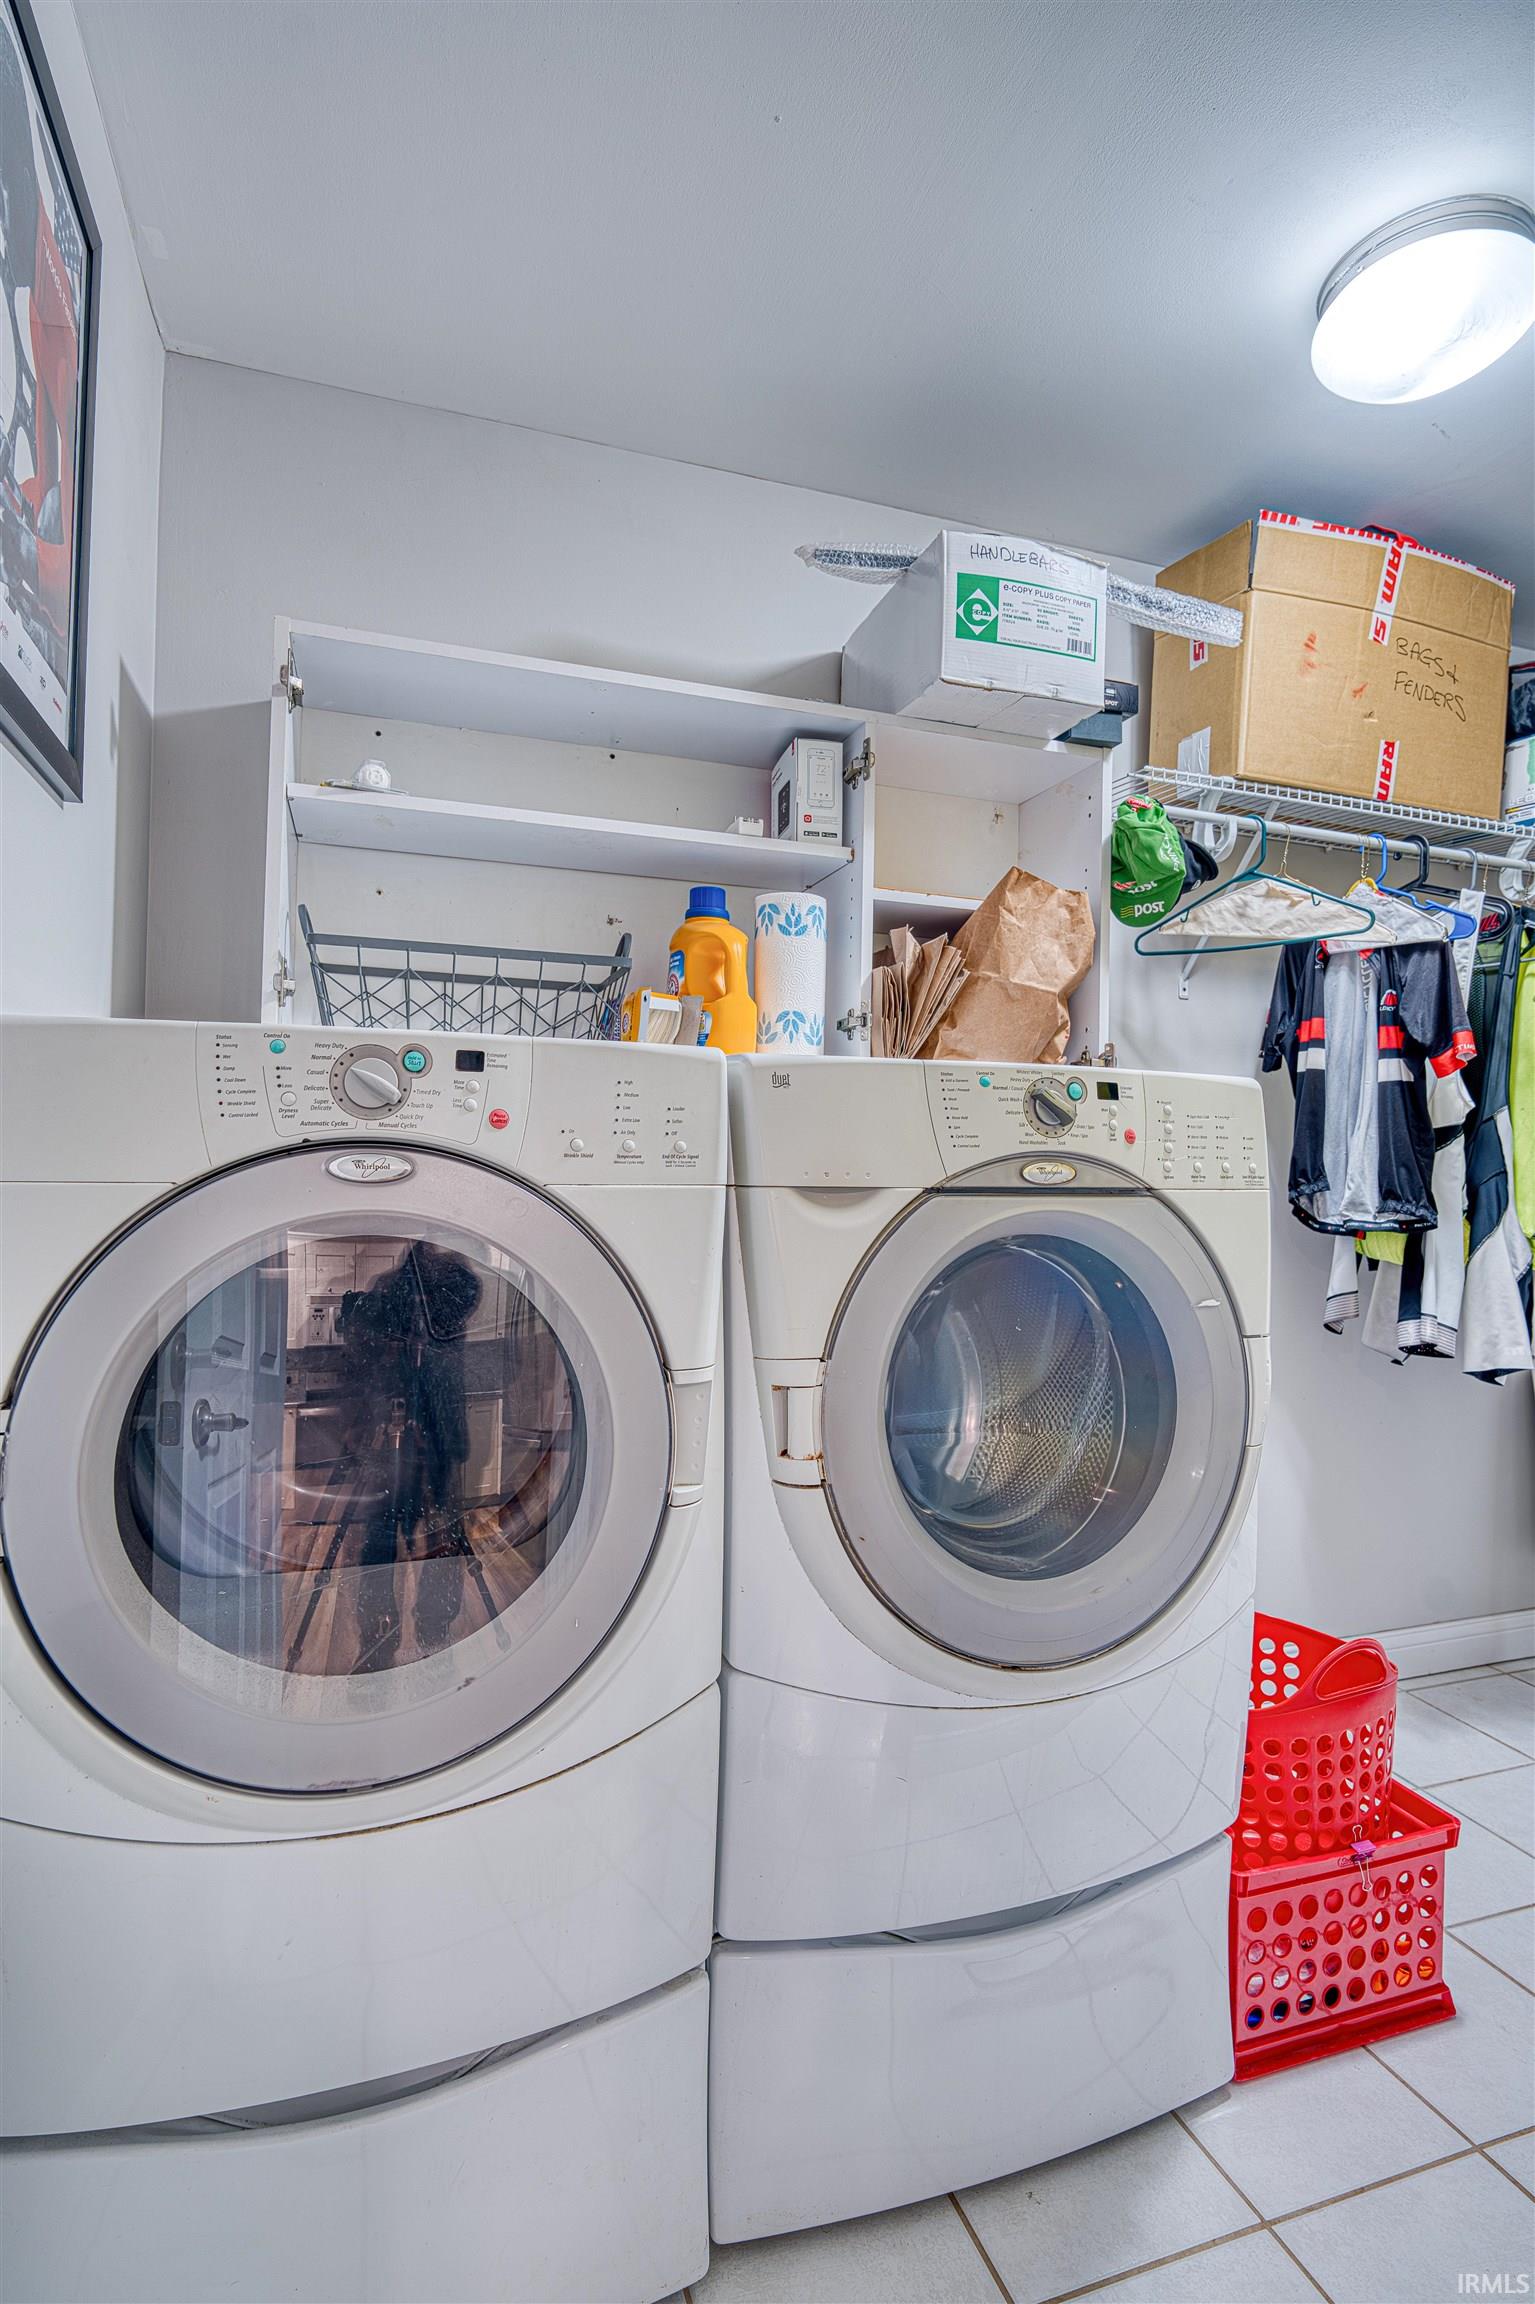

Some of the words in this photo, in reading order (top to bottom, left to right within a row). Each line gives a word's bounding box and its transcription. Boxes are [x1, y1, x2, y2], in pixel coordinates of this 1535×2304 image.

[970, 543, 1070, 575] HANDLEBARS
[1003, 584, 1033, 595] e-COPY
[1035, 589, 1054, 600] PLUS
[1055, 595, 1073, 604] COPY
[1073, 598, 1092, 608] PAPER
[1396, 637, 1445, 677] BAGS
[1394, 670, 1466, 722] FENDERS
[1134, 901, 1165, 917] post
[772, 1072, 791, 1085] duet
[354, 1162, 390, 1170] Whirlpool
